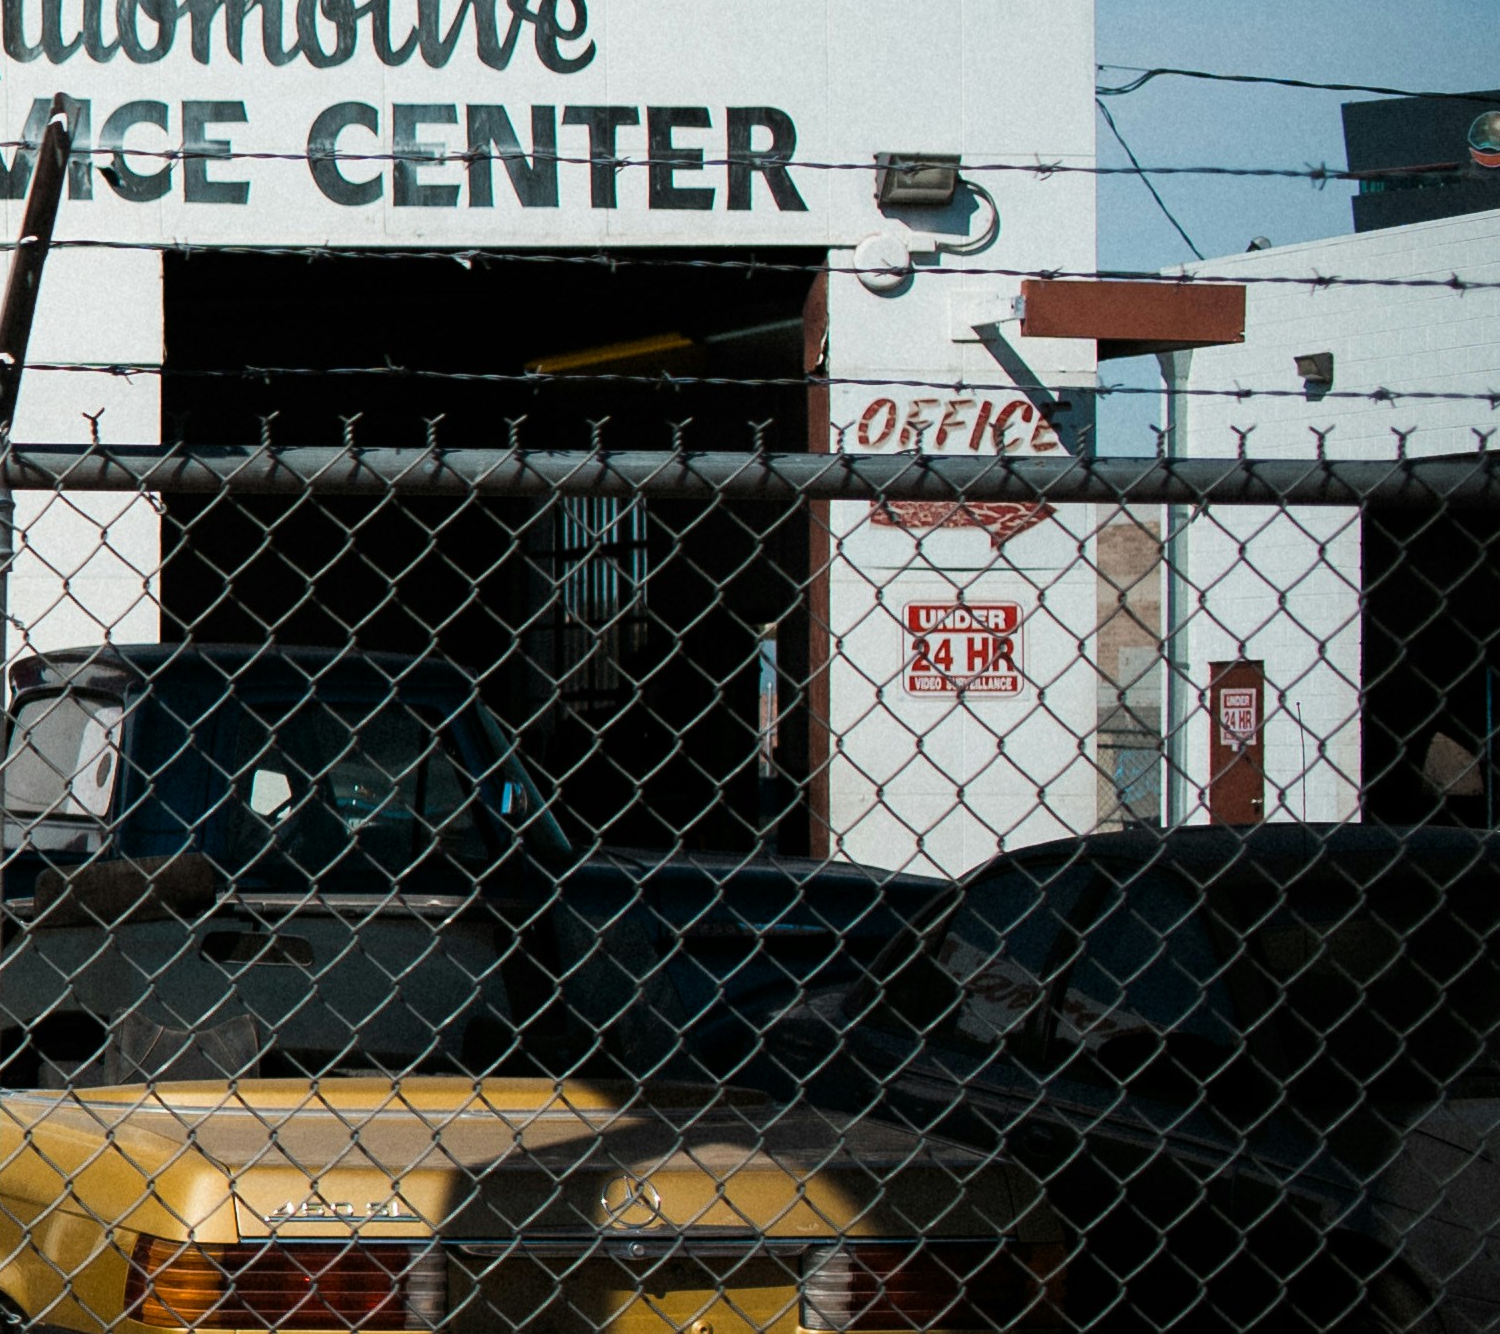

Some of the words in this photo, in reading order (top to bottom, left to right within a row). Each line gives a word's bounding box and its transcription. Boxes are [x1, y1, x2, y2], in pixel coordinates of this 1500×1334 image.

[306, 102, 809, 213] CENTER
[857, 397, 1073, 453] OFFICE
[918, 608, 1007, 630] UNDER
[911, 637, 954, 672] 24
[967, 636, 1015, 672] HR
[914, 677, 942, 691] VIDEO
[1224, 710, 1236, 730] 24
[1239, 710, 1252, 730] HR
